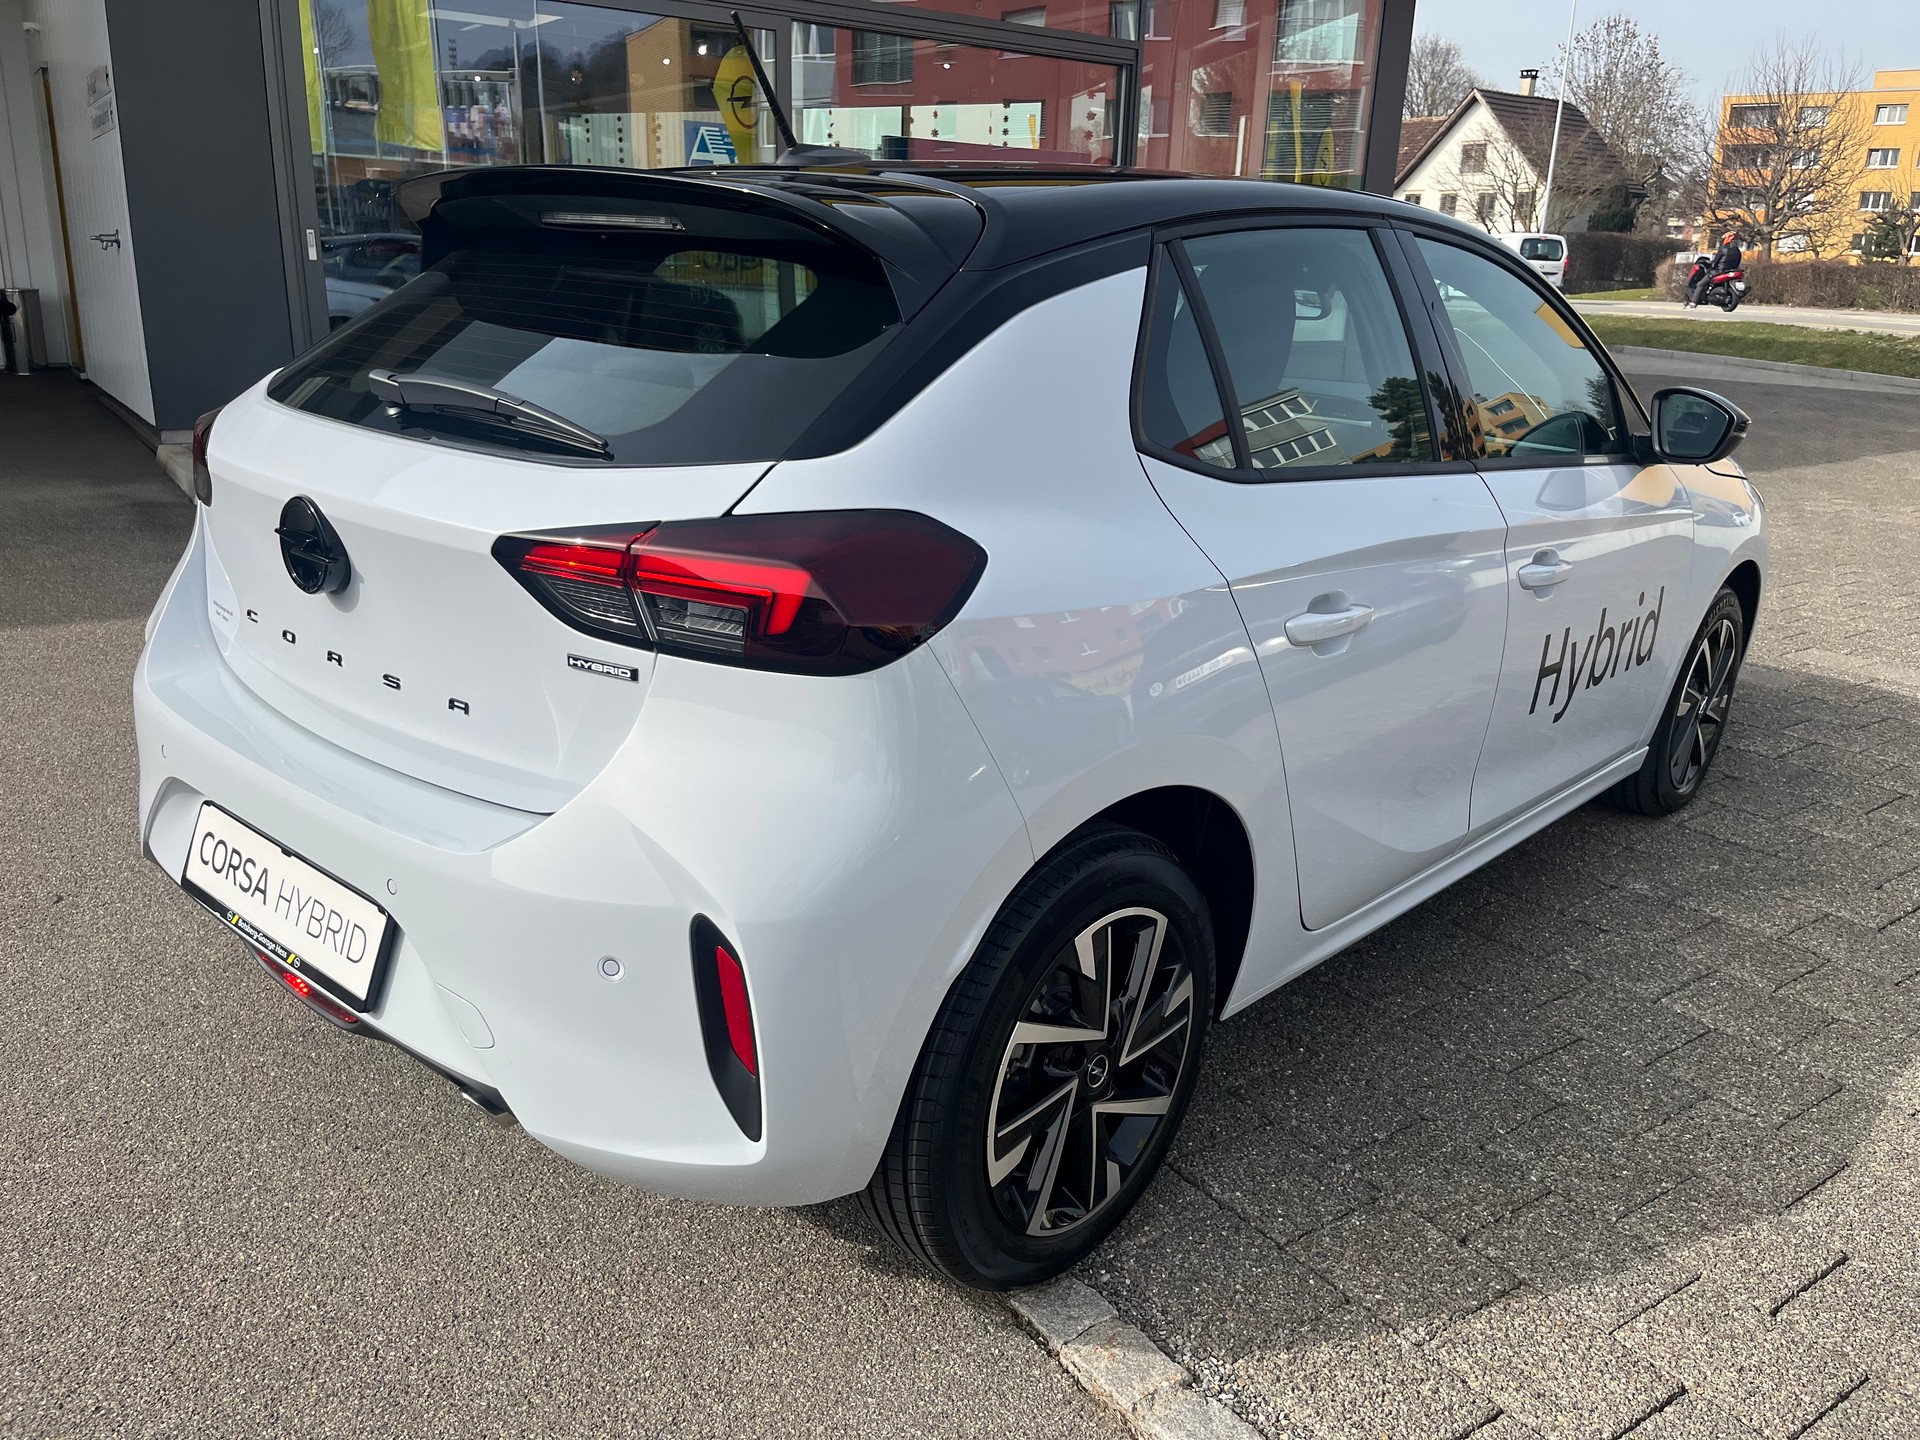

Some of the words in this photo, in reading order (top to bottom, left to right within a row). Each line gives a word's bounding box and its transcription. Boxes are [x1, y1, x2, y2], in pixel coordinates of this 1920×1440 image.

[246, 608, 470, 716] CORSA
[569, 657, 631, 678] HYBRID
[1528, 585, 1665, 724] Hybrid
[200, 831, 269, 906] CORSA
[274, 878, 367, 964] HYBRID
[275, 944, 288, 958] Hess
